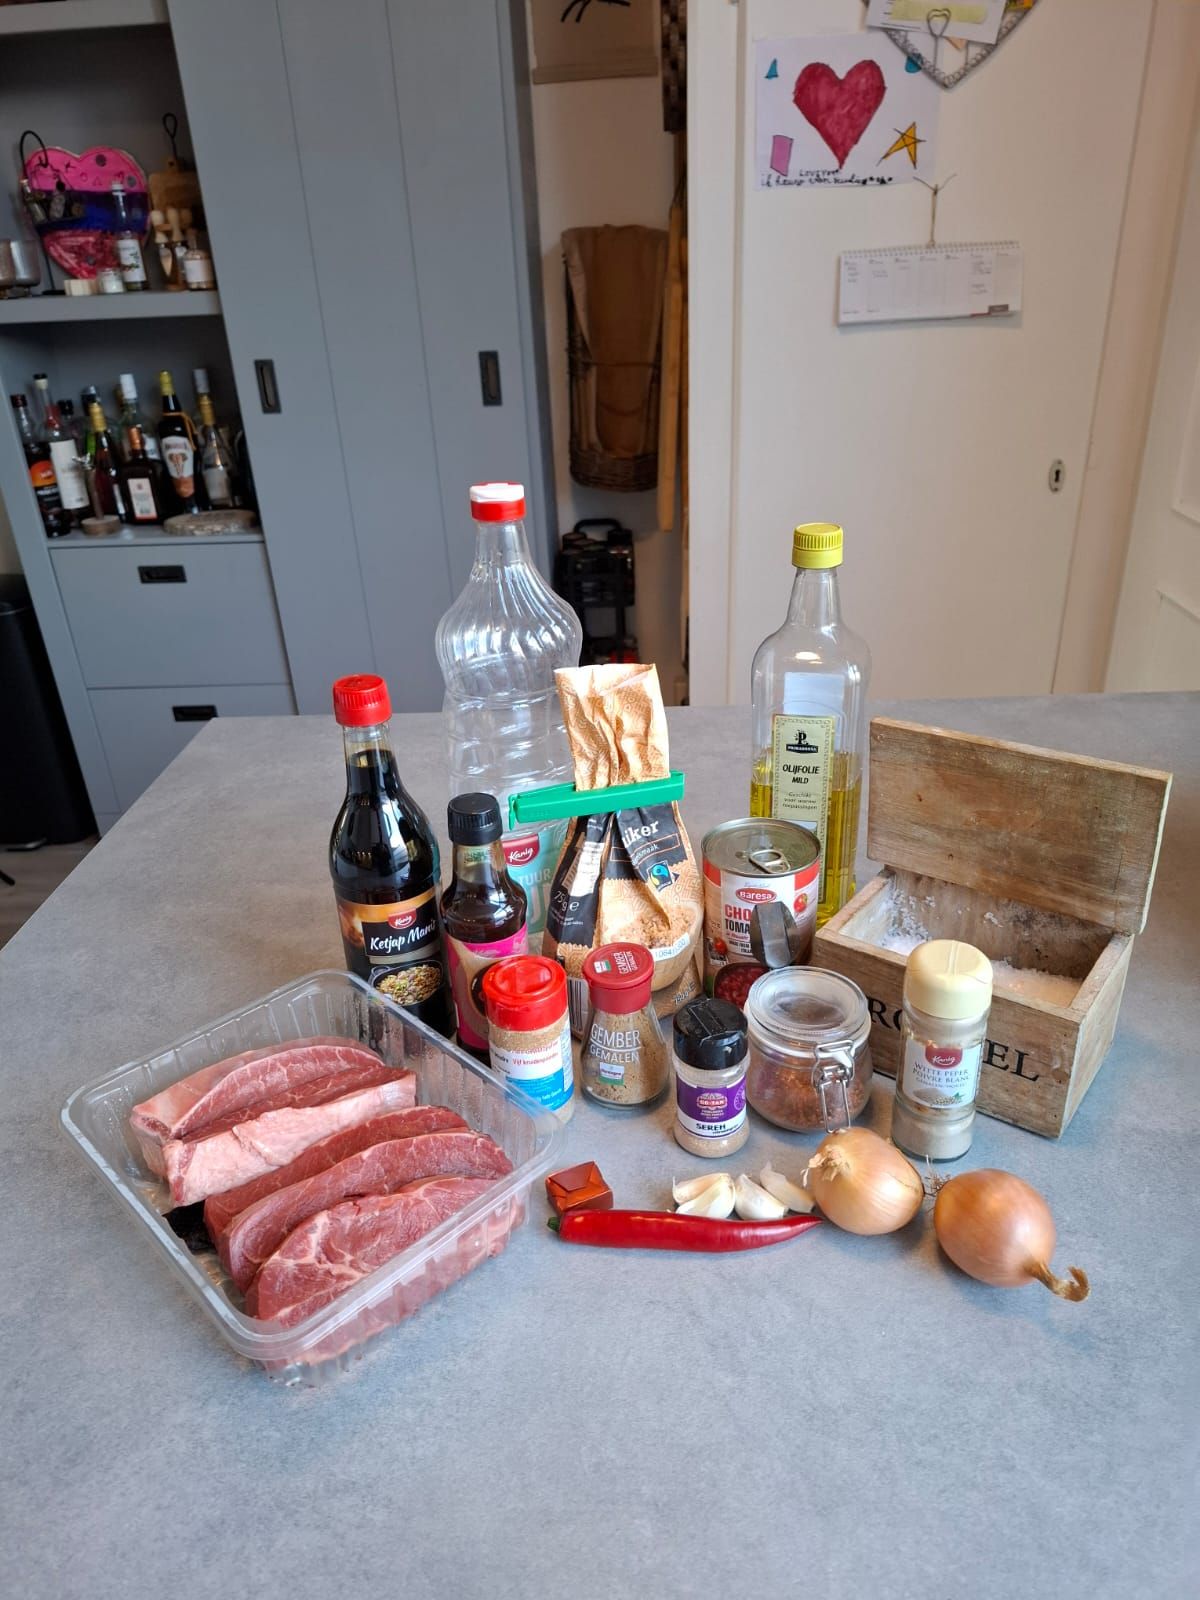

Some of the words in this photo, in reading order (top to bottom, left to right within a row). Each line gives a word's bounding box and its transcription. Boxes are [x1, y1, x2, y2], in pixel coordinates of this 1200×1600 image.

[782, 764, 820, 774] OLIJFOLIE
[792, 776, 809, 784] MILD
[739, 891, 772, 900] Baresa
[725, 918, 751, 935] TOMA
[370, 935, 406, 954] Ketjap
[591, 1023, 641, 1048] GEMBER
[590, 1043, 640, 1062] GEMALEN
[982, 1038, 1040, 1081] EL
[912, 1067, 942, 1082] POIVRE
[913, 1061, 941, 1076] WITTE
[695, 1122, 726, 1131] SEREH
